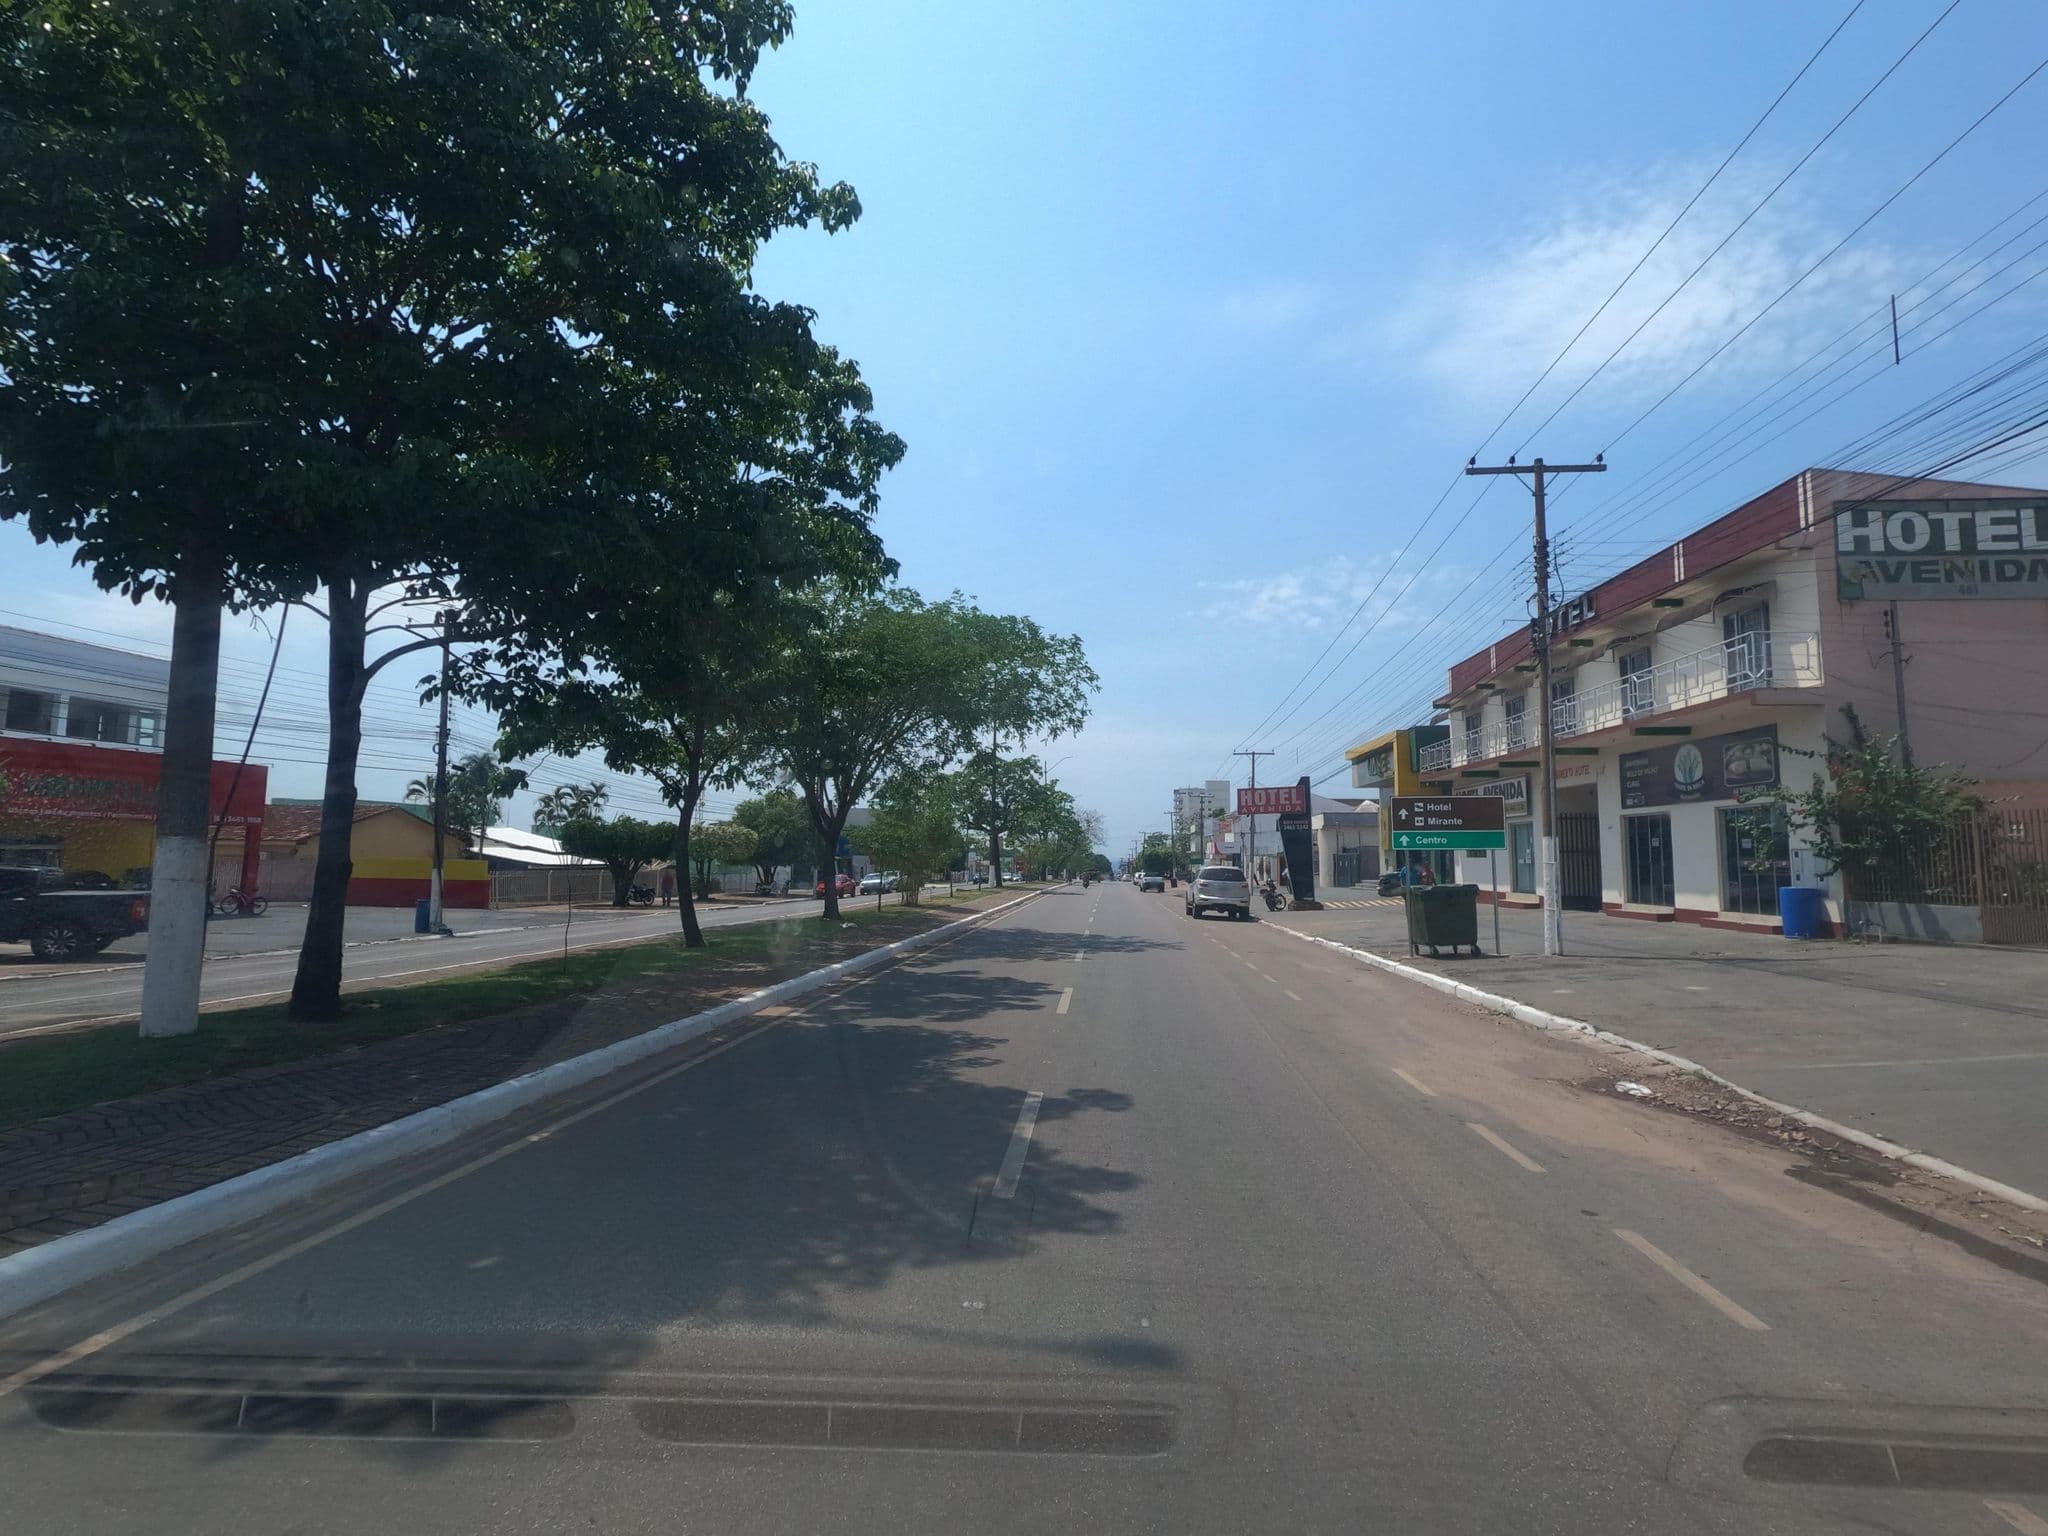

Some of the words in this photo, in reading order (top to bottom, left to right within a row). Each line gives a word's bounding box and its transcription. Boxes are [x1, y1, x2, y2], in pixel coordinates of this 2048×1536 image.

[1836, 508, 2048, 552] HOTEL
[1240, 788, 1302, 806] HOTEL
[1241, 805, 1302, 813] AVENIDA
[1426, 803, 1452, 811] Hotel
[1427, 817, 1463, 825] Mirante
[1415, 836, 1447, 845] Centro
